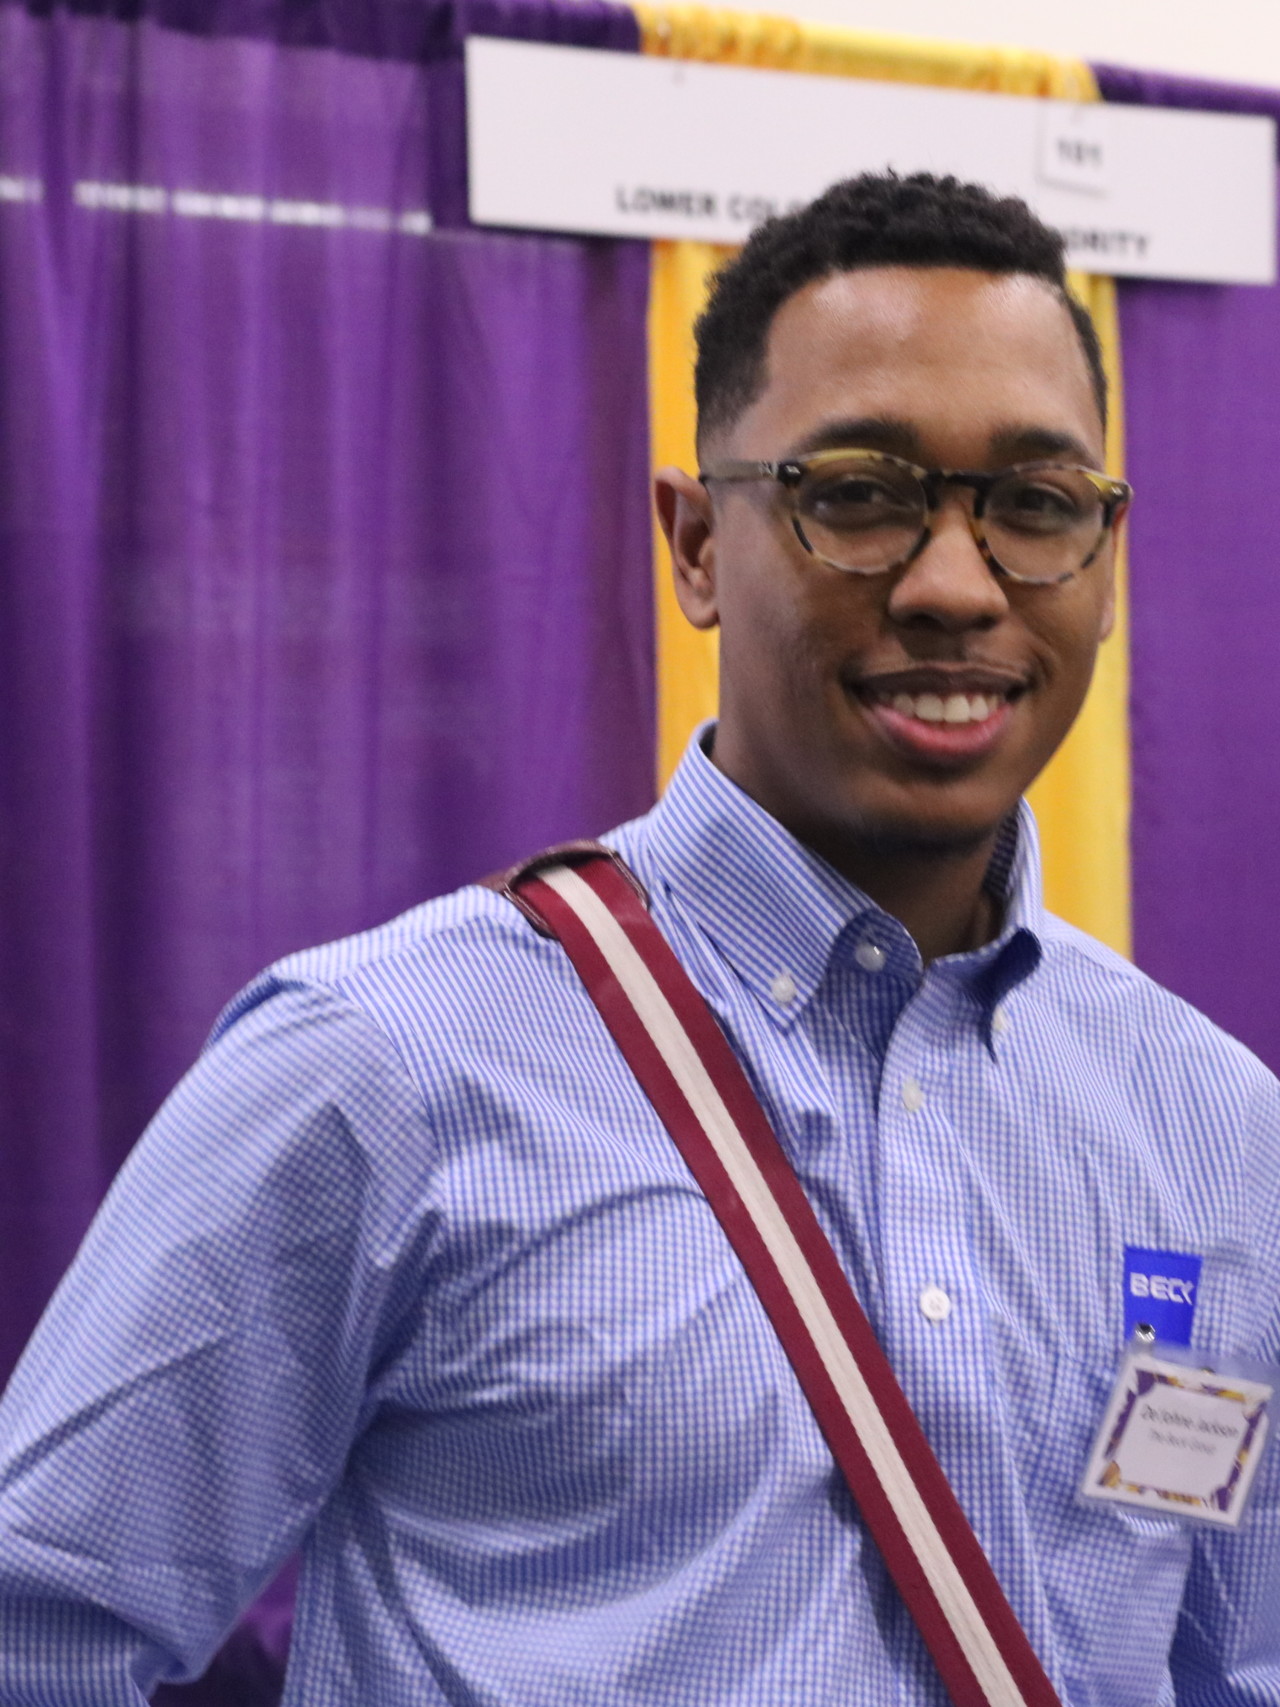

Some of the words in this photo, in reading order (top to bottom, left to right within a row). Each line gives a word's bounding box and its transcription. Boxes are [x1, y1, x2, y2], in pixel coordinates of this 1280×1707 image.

[615, 184, 714, 218] LOWER
[1062, 225, 1149, 259] ORITY
[1129, 1271, 1195, 1306] BECK
